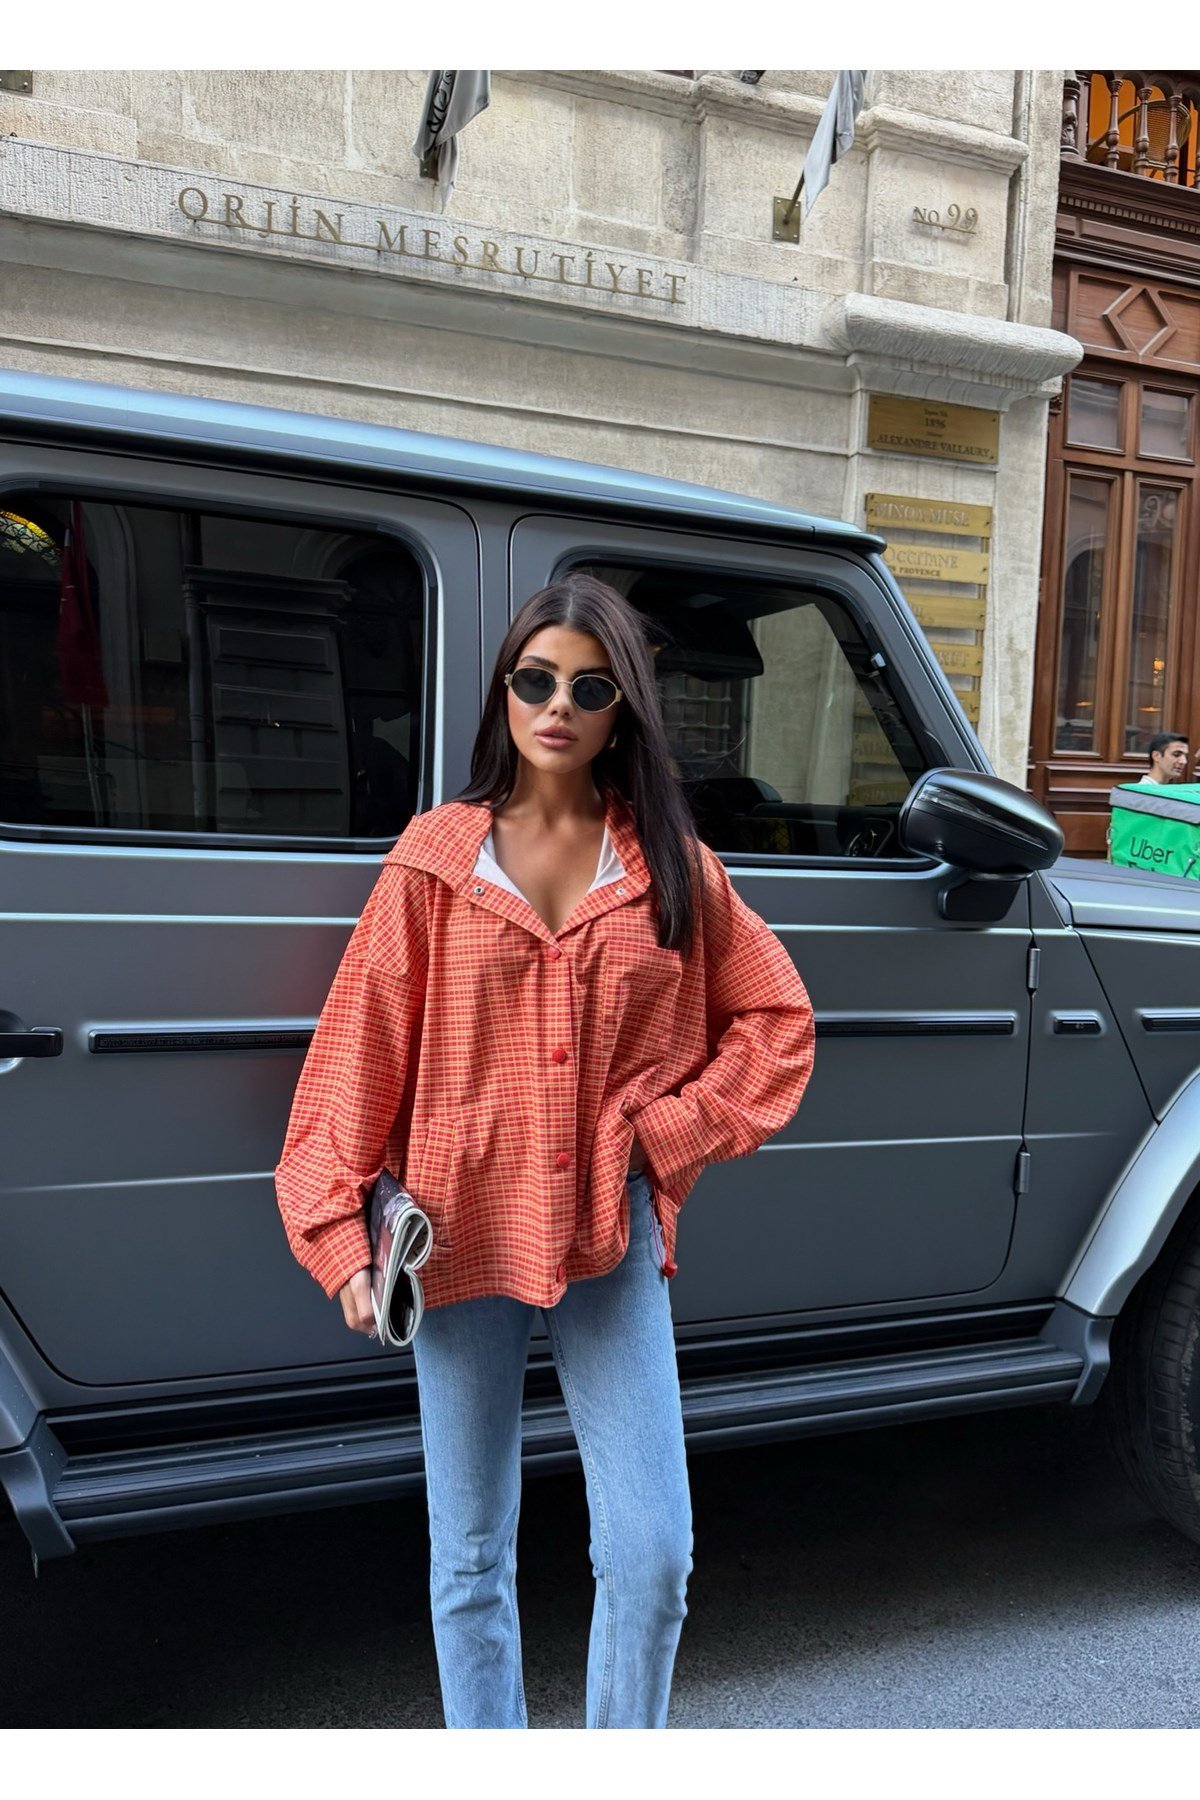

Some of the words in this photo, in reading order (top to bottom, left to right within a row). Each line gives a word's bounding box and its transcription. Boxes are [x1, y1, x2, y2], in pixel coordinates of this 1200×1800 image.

[948, 203, 979, 234] 99
[178, 187, 345, 243] ORJİN
[376, 220, 687, 304] MEŞRUTİYET
[876, 434, 938, 450] ALEXANDRE
[940, 441, 990, 458] VALLAURY
[899, 567, 941, 577] PROVENCE
[1130, 837, 1174, 864] Uber
